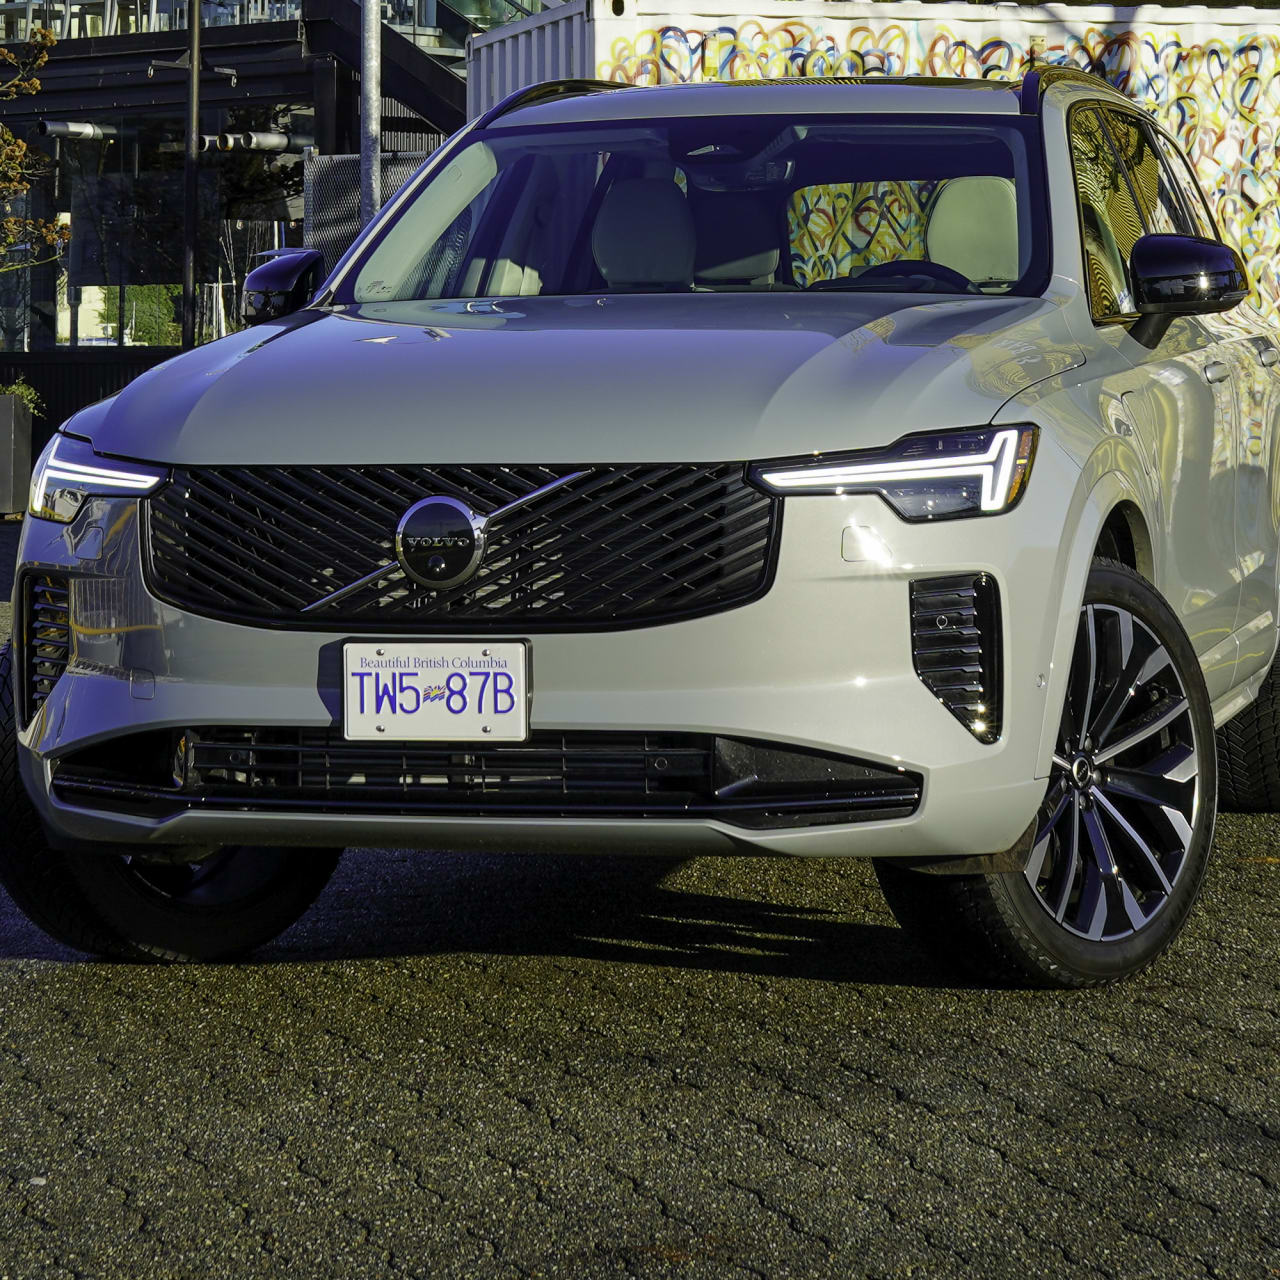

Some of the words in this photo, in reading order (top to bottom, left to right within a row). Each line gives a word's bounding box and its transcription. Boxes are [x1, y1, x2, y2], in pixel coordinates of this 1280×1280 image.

[406, 537, 470, 547] VOLVO
[359, 656, 410, 669] Beautiful
[413, 656, 449, 669] British
[451, 656, 508, 669] Columbia
[351, 672, 421, 714] TW5
[445, 672, 516, 714] 87B
